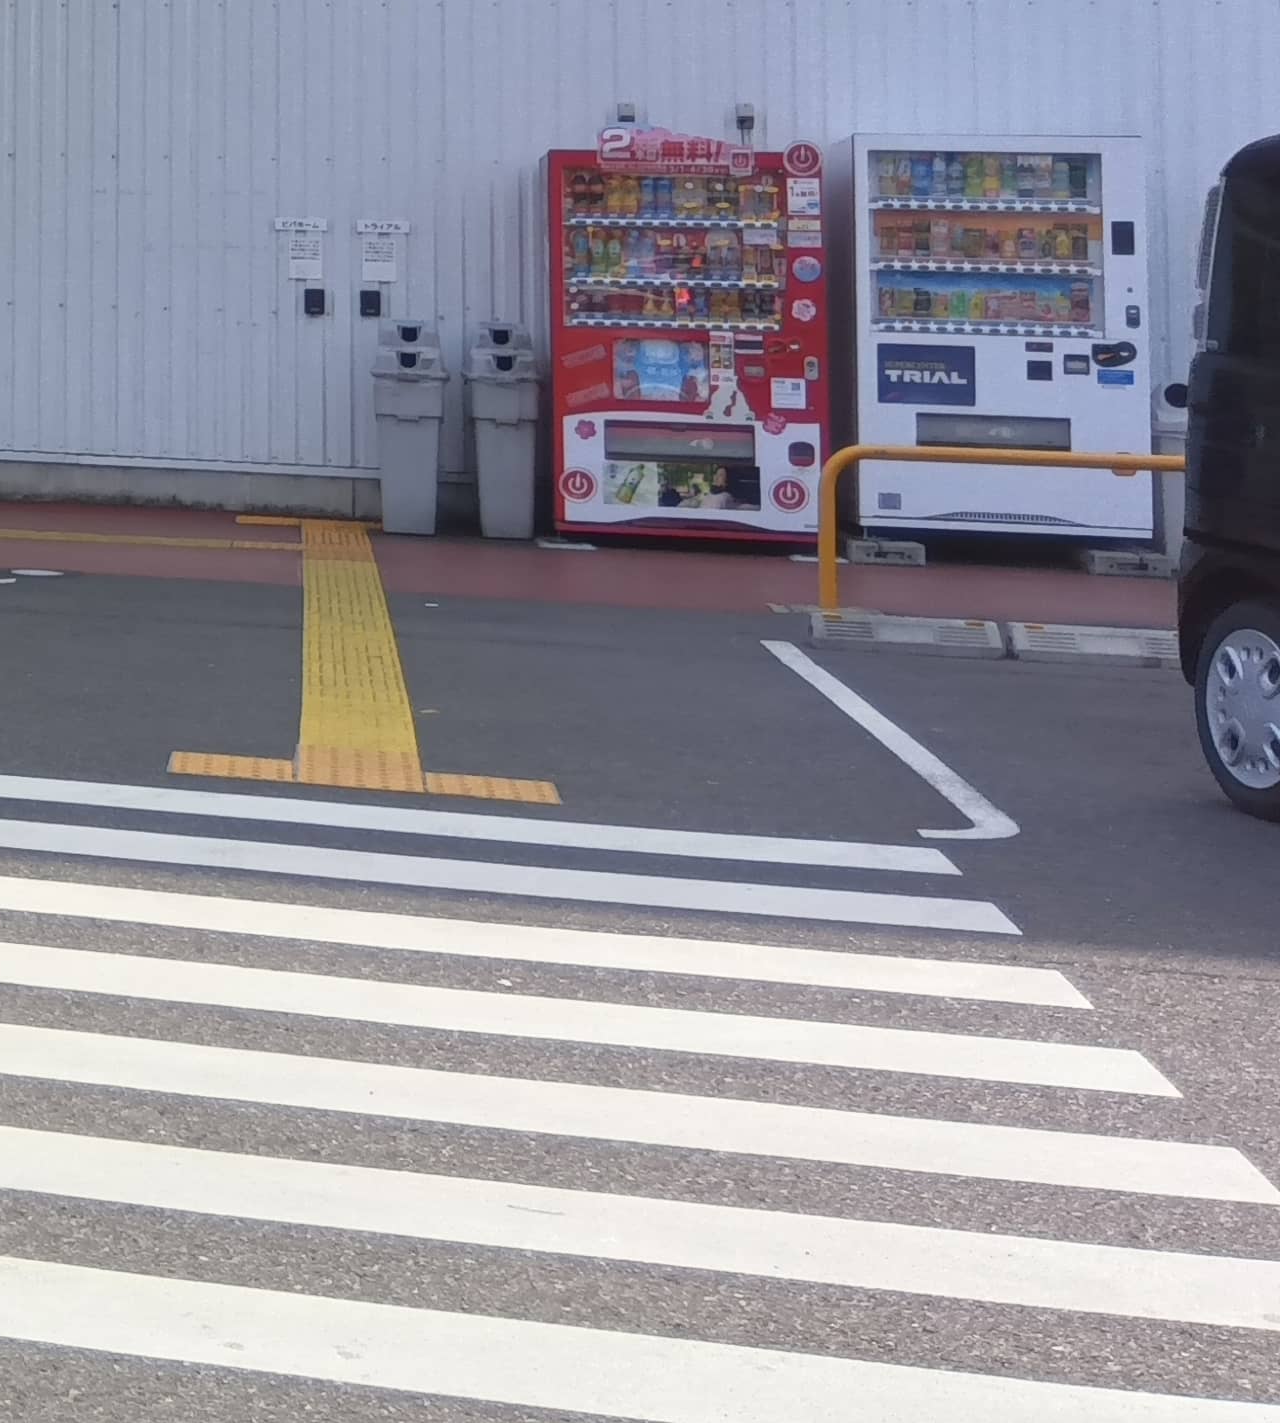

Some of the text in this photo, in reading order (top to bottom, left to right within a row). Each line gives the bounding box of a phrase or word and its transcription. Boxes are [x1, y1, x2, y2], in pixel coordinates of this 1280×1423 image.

[364, 222, 401, 231] トライアル
[884, 369, 968, 385] TRIAL
